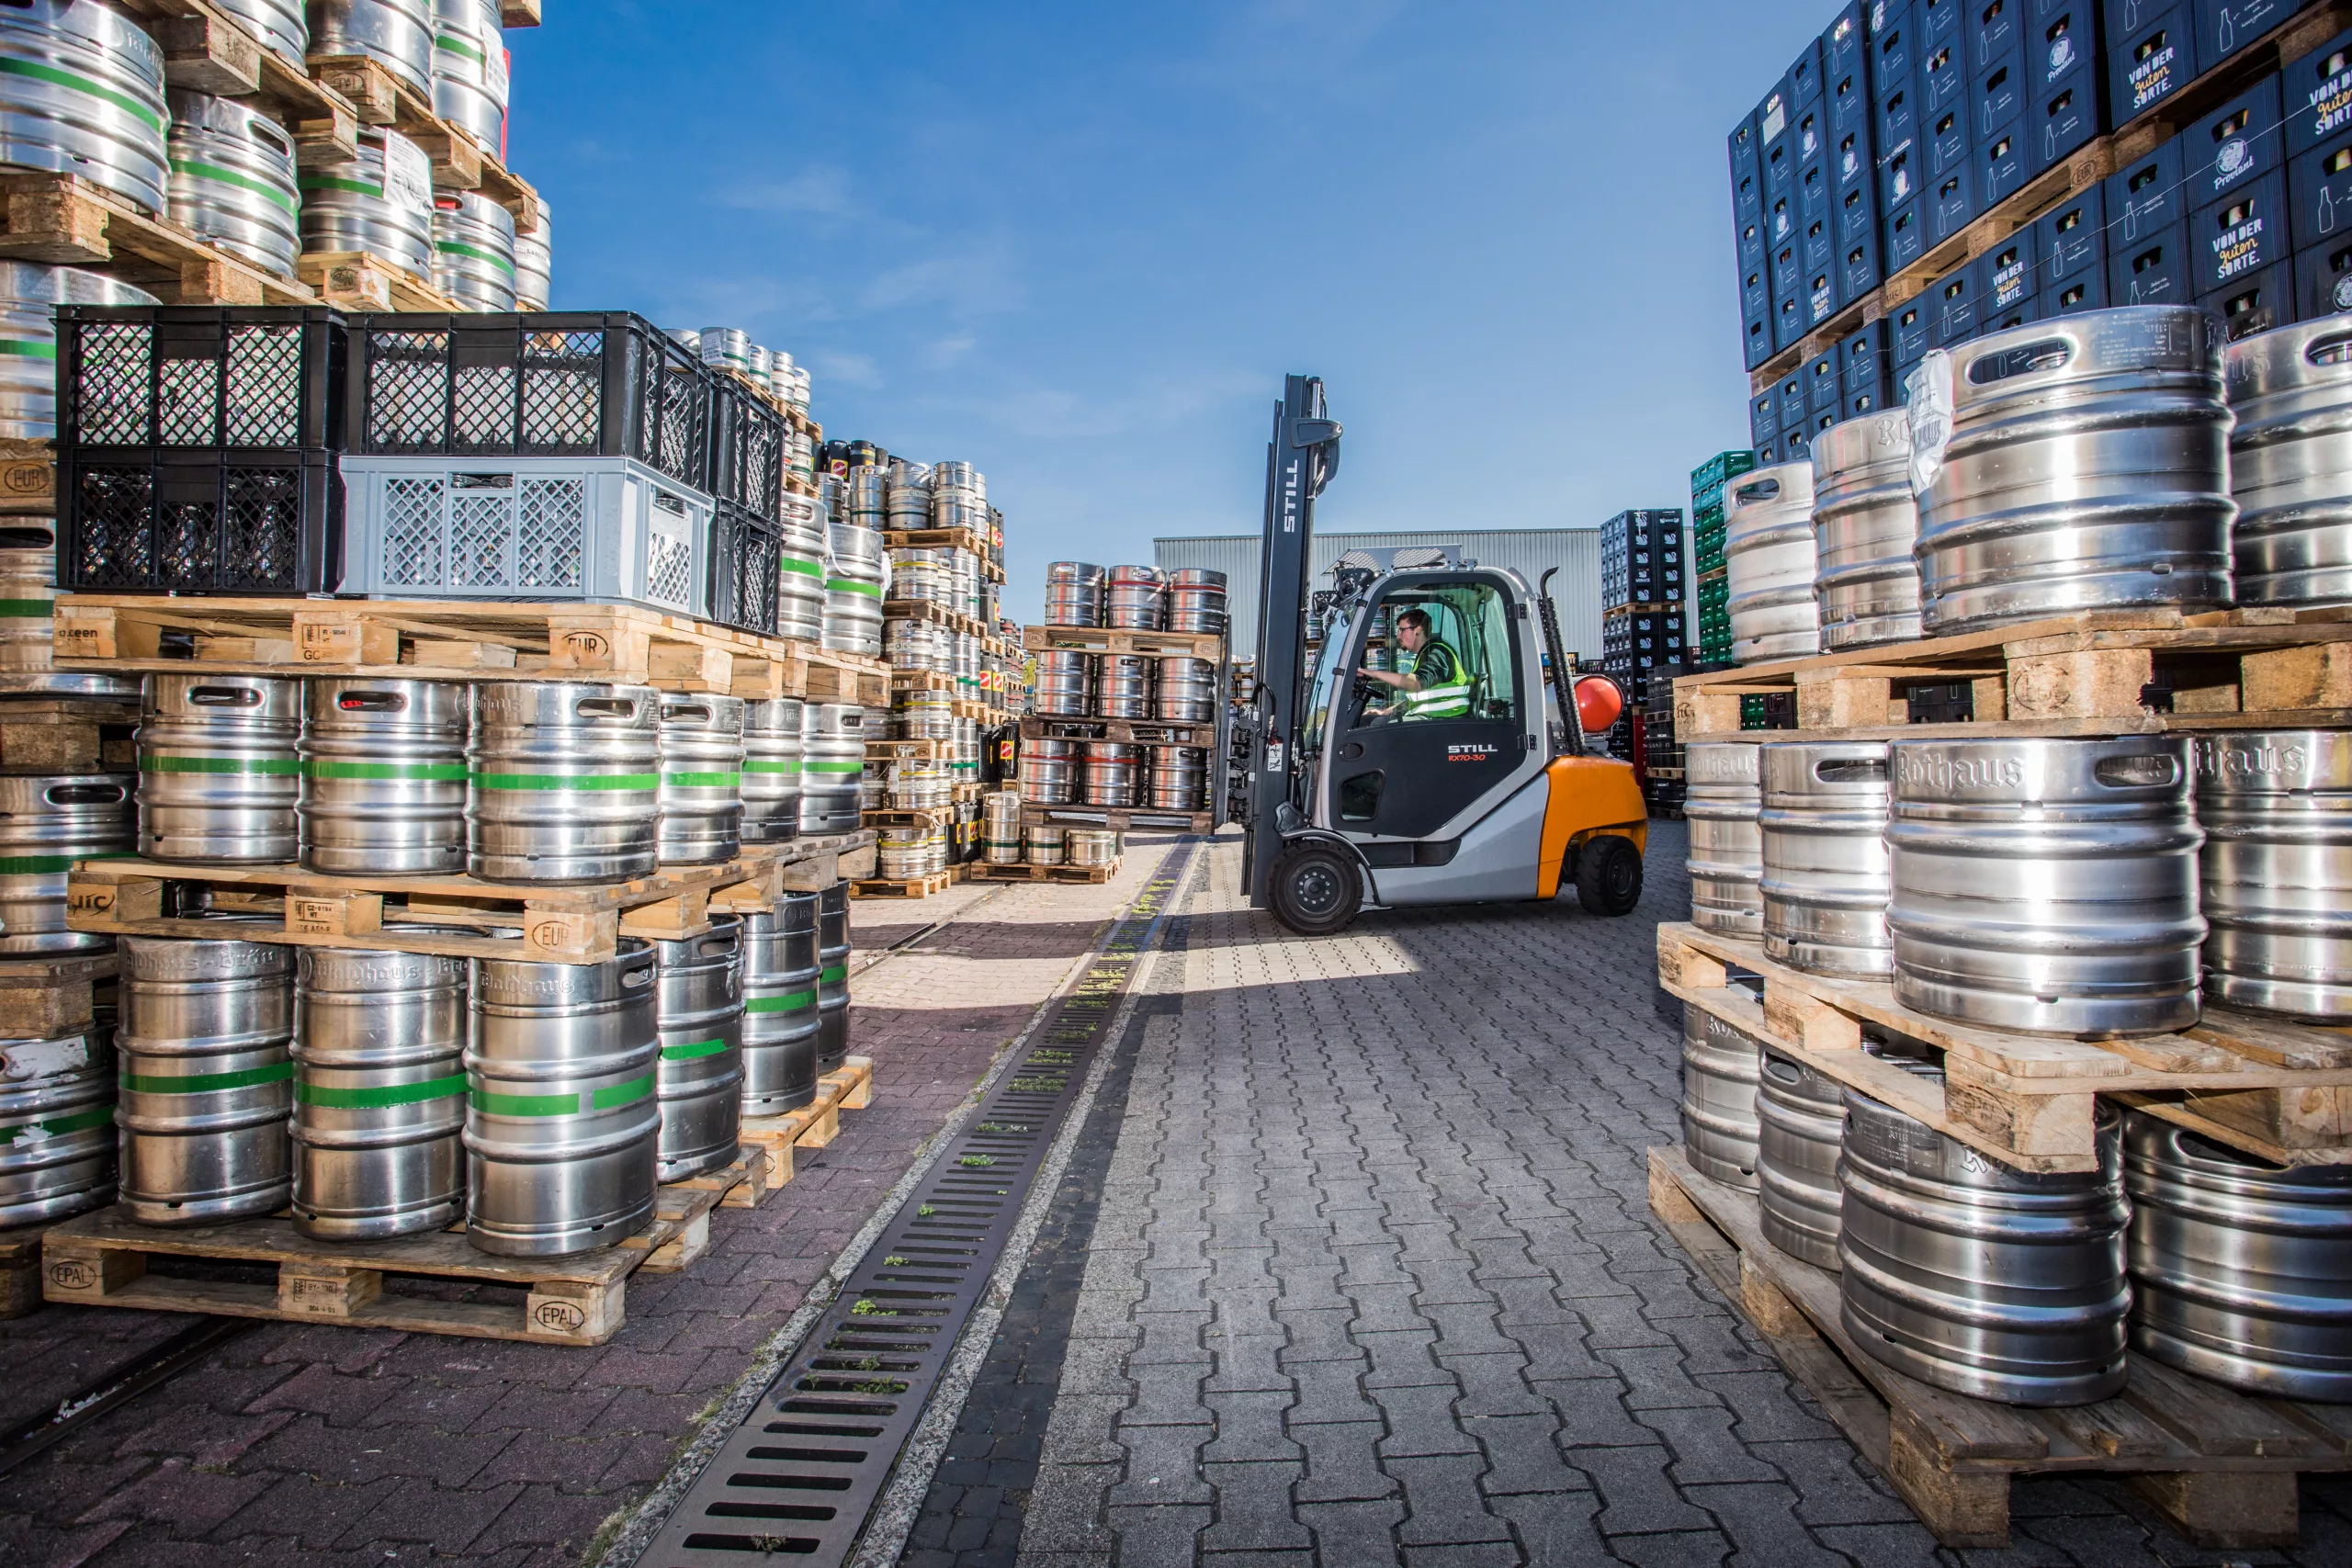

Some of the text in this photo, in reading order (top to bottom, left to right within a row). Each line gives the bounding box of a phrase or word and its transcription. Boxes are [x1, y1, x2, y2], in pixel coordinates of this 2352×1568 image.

[2128, 47, 2174, 85] VON DER
[2133, 77, 2172, 109] SORTE.
[2134, 65, 2170, 99] guten
[2309, 77, 2339, 107] VON
[2317, 88, 2352, 123] gute
[2314, 108, 2352, 136] SORT
[2075, 166, 2091, 183] EUR
[2213, 154, 2255, 190] Proviant
[2212, 218, 2263, 254] VON DER
[2217, 250, 2261, 279] SORTE.
[2219, 237, 2259, 269] guten
[1992, 261, 2024, 287] VON DER
[1996, 287, 2023, 308] SORTE.
[14, 470, 41, 488] EUR
[1283, 459, 1298, 533] STILL
[1448, 744, 1498, 753] STILL
[1896, 749, 2027, 793] Rothaus
[2195, 742, 2309, 785] thaus
[542, 926, 569, 946] EUR
[126, 952, 198, 972] aldhaus
[479, 970, 575, 997] Waldhaus
[57, 1267, 90, 1284] EPAL
[543, 1307, 577, 1325] EPAL
